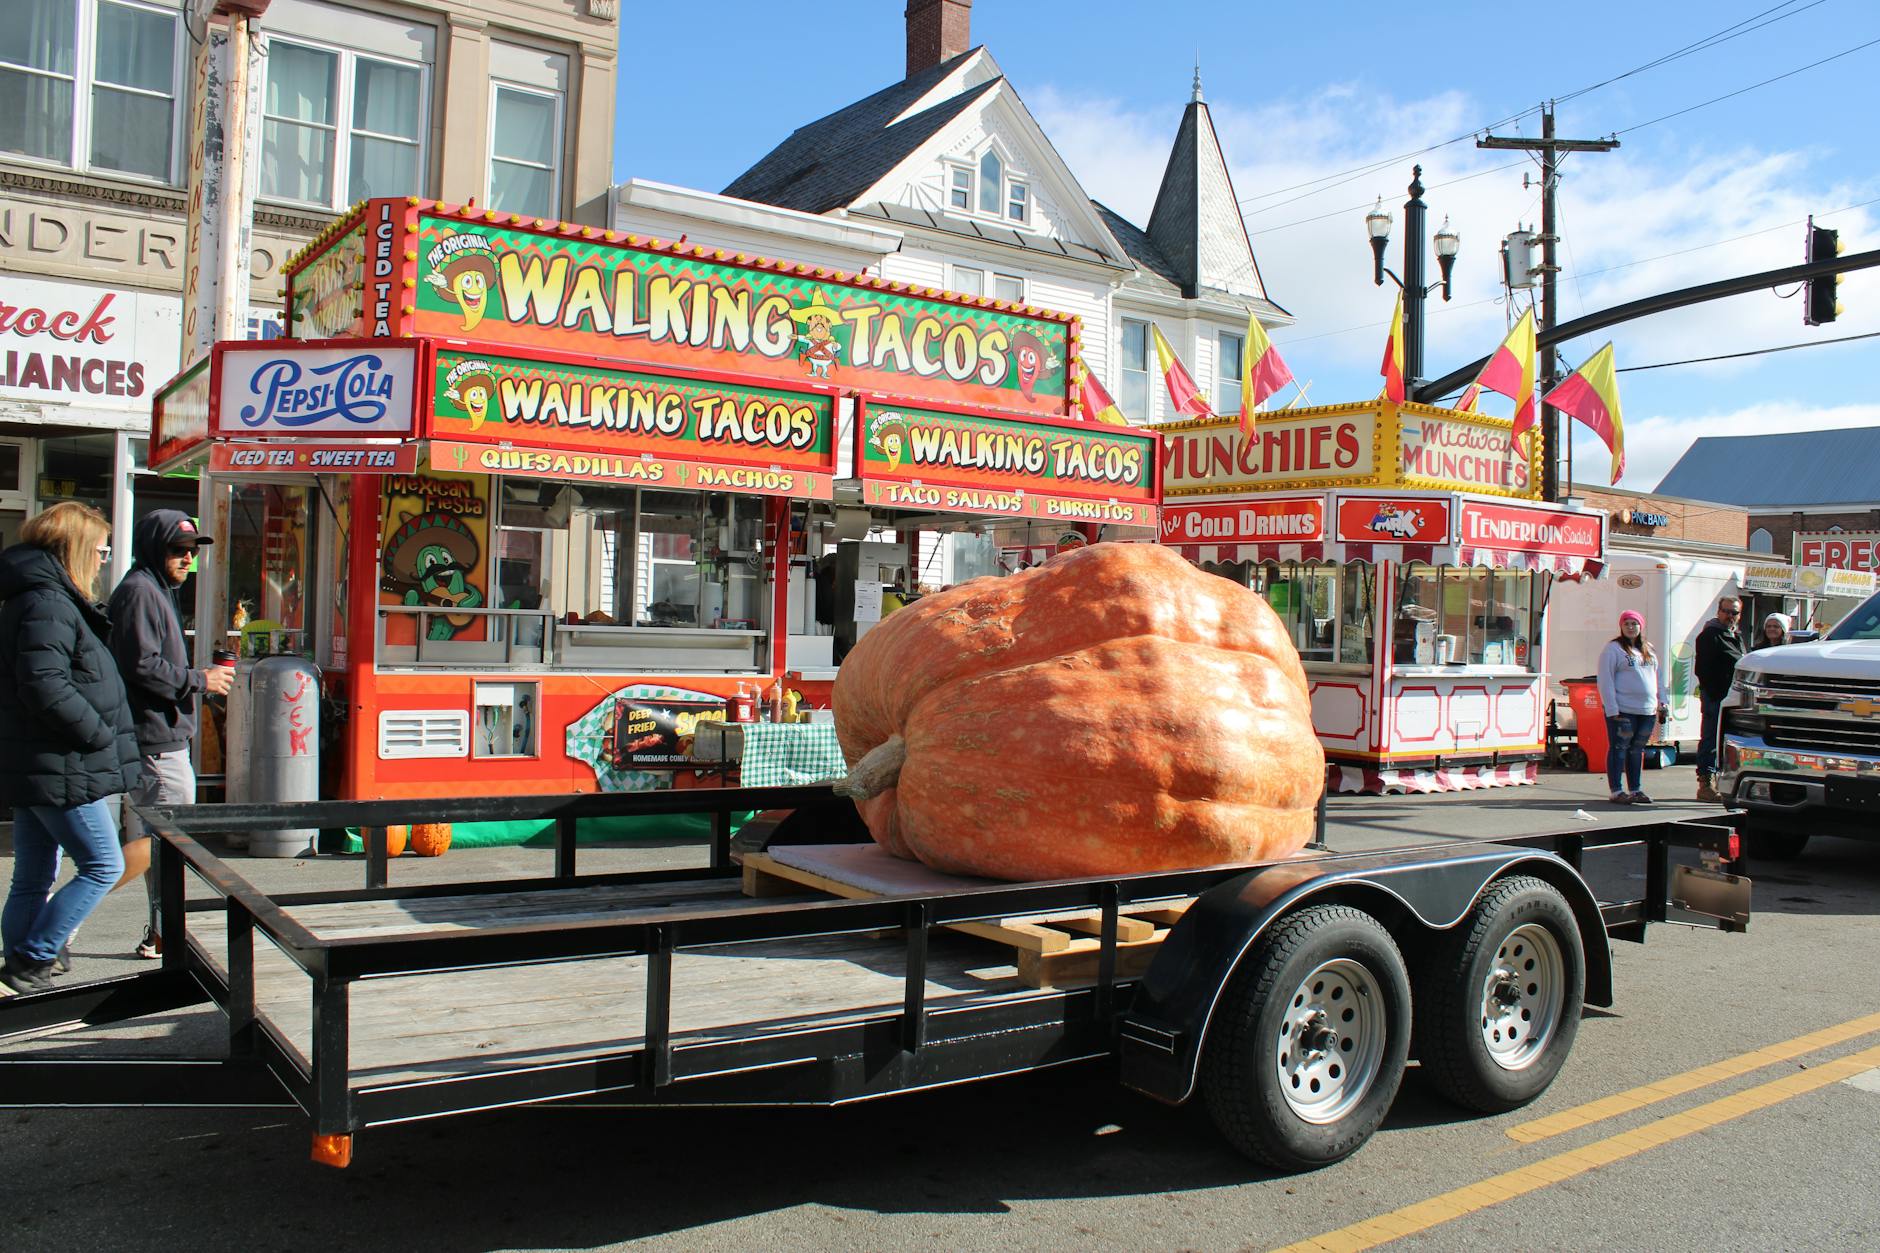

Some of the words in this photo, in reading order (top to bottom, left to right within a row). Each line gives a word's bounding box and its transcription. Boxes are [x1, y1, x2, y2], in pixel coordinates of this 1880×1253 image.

[376, 204, 391, 276] ICED
[427, 242, 446, 269] THE
[441, 233, 492, 255] ORIGINAL
[374, 282, 391, 338] TEA
[499, 251, 795, 358] WALKING
[840, 304, 1010, 386] TACOS
[0, 349, 145, 398] IANCES
[500, 377, 683, 433] WALKING
[693, 396, 815, 449] TACOS
[230, 450, 265, 465] ICED
[268, 450, 295, 466] TEA
[310, 451, 365, 466] SWEET
[367, 451, 395, 467] TEA
[480, 449, 664, 480] QUESADILLAS
[696, 466, 793, 491] NACHOS
[909, 425, 1045, 473] WALKING
[1051, 439, 1142, 482] TACOS
[1403, 443, 1528, 488] MUNCHIES
[886, 485, 941, 506] TACO
[946, 491, 1022, 512] SALADS
[1046, 499, 1134, 522] BURRITOS
[1632, 511, 1648, 525] PNC
[1648, 513, 1669, 527] BANK
[1467, 511, 1563, 544] TENDERLOIN
[1747, 566, 1793, 580] LEMONADE
[1801, 540, 1880, 573] FRE
[1832, 571, 1873, 587] LEMONADE
[627, 721, 657, 735] FRIED
[628, 709, 652, 721] DEEP
[632, 754, 668, 763] HOMEMADE
